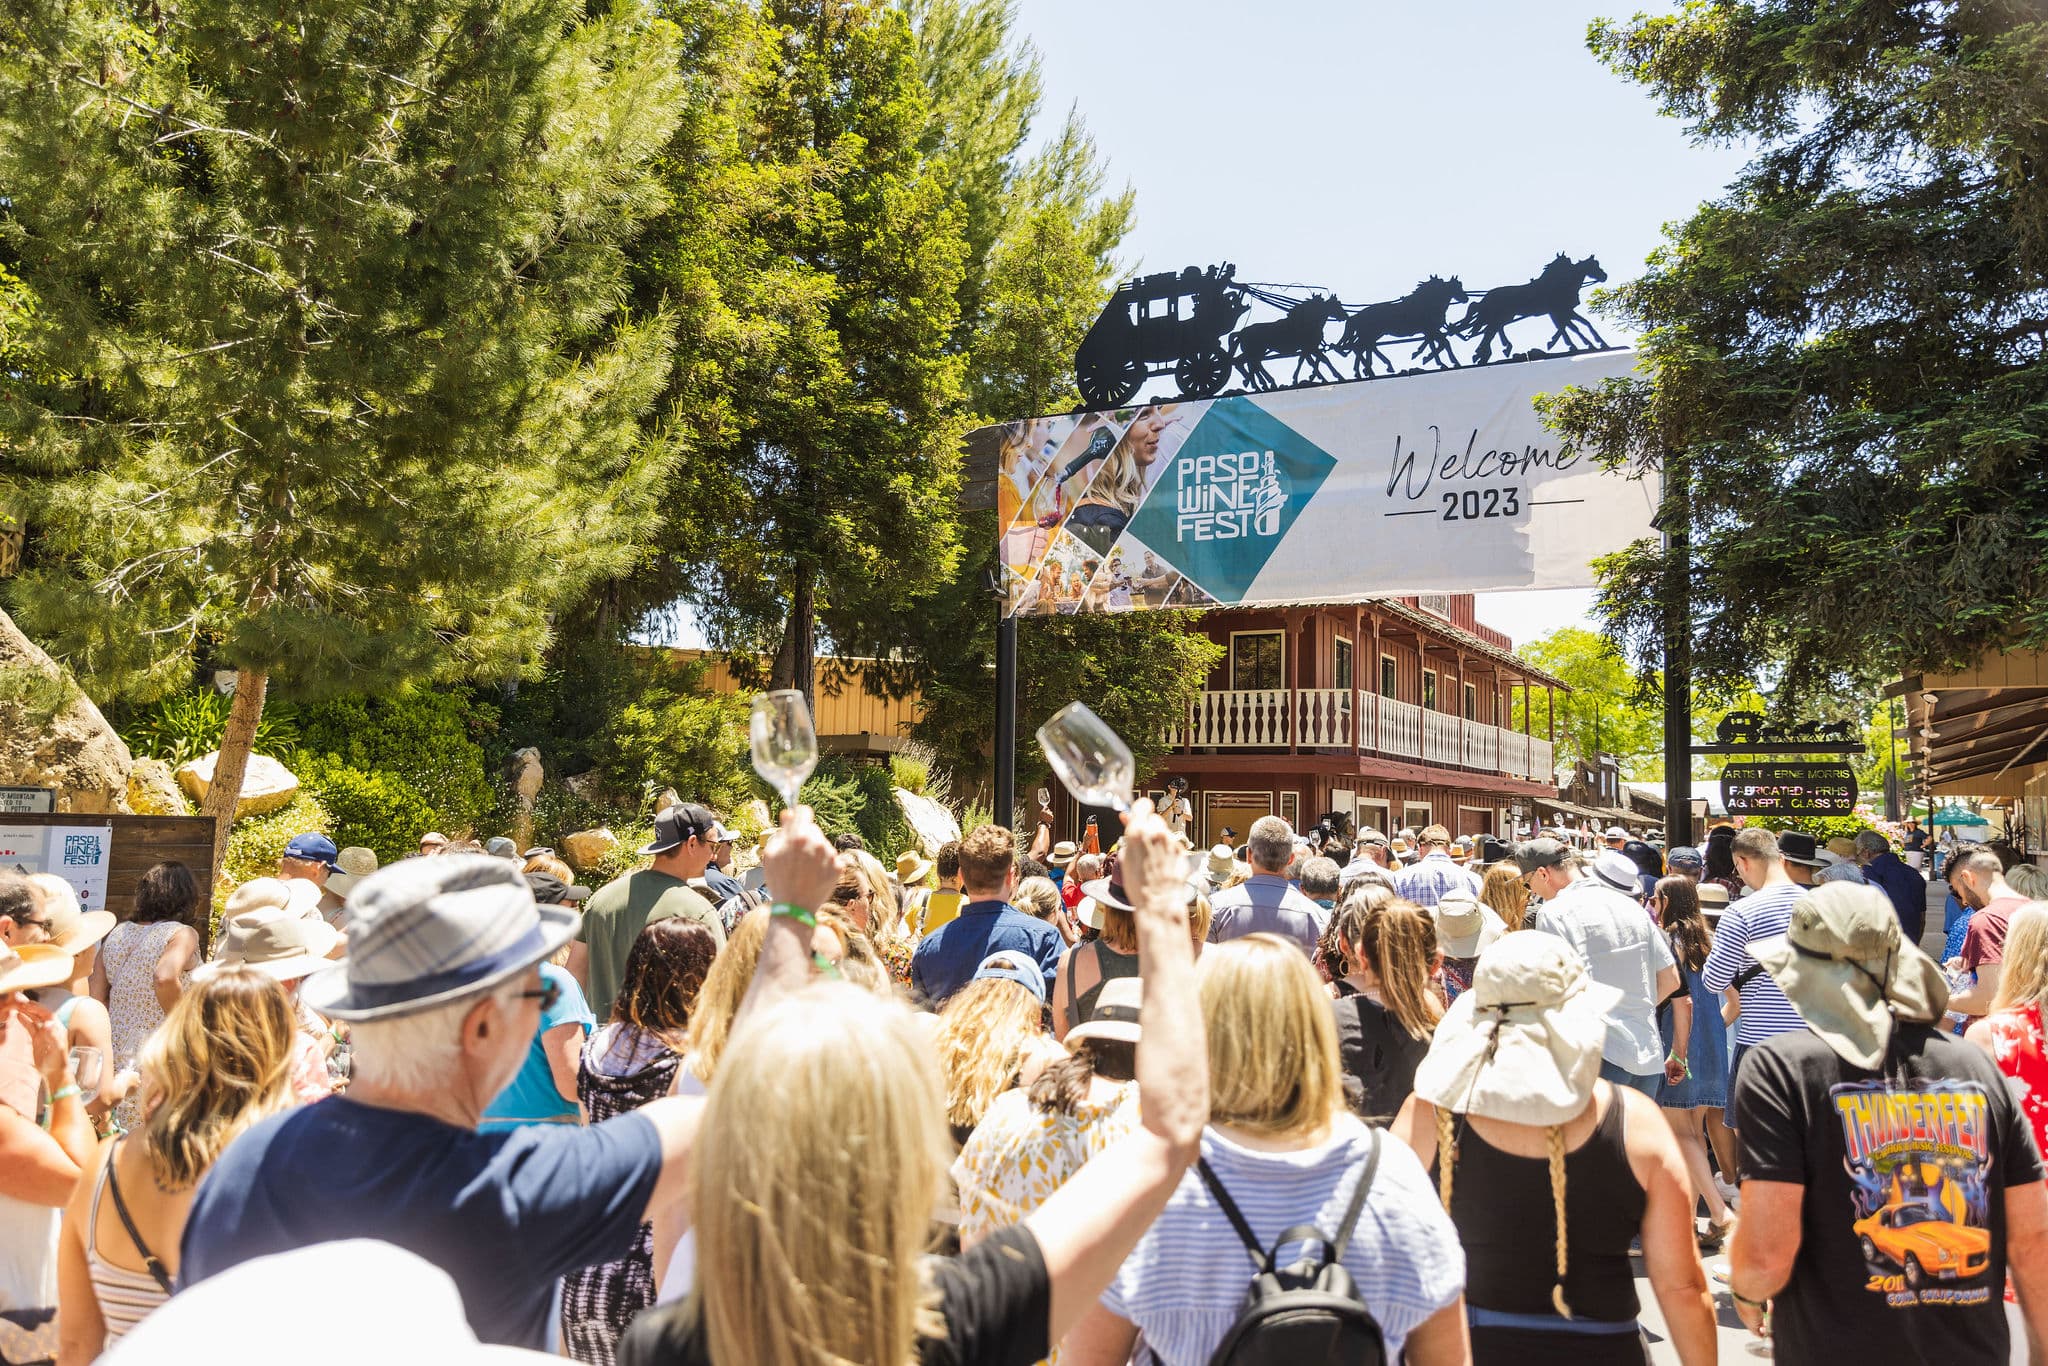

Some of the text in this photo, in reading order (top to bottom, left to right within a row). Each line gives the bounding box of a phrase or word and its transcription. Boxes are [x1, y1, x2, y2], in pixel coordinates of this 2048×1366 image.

[1387, 425, 1582, 500] Welcome
[1177, 452, 1260, 489] PASO
[1443, 487, 1519, 521] 2023
[1177, 510, 1254, 542] FEST
[1725, 770, 1763, 779] ARTIST
[1808, 769, 1850, 779] MORRIS
[1729, 786, 1803, 796] FABRICATED
[1815, 786, 1848, 796] PRHS
[1751, 799, 1783, 808] DEPT.
[1791, 799, 1831, 808] CLASS
[65, 836, 94, 847] PASO
[64, 855, 90, 865] FEST
